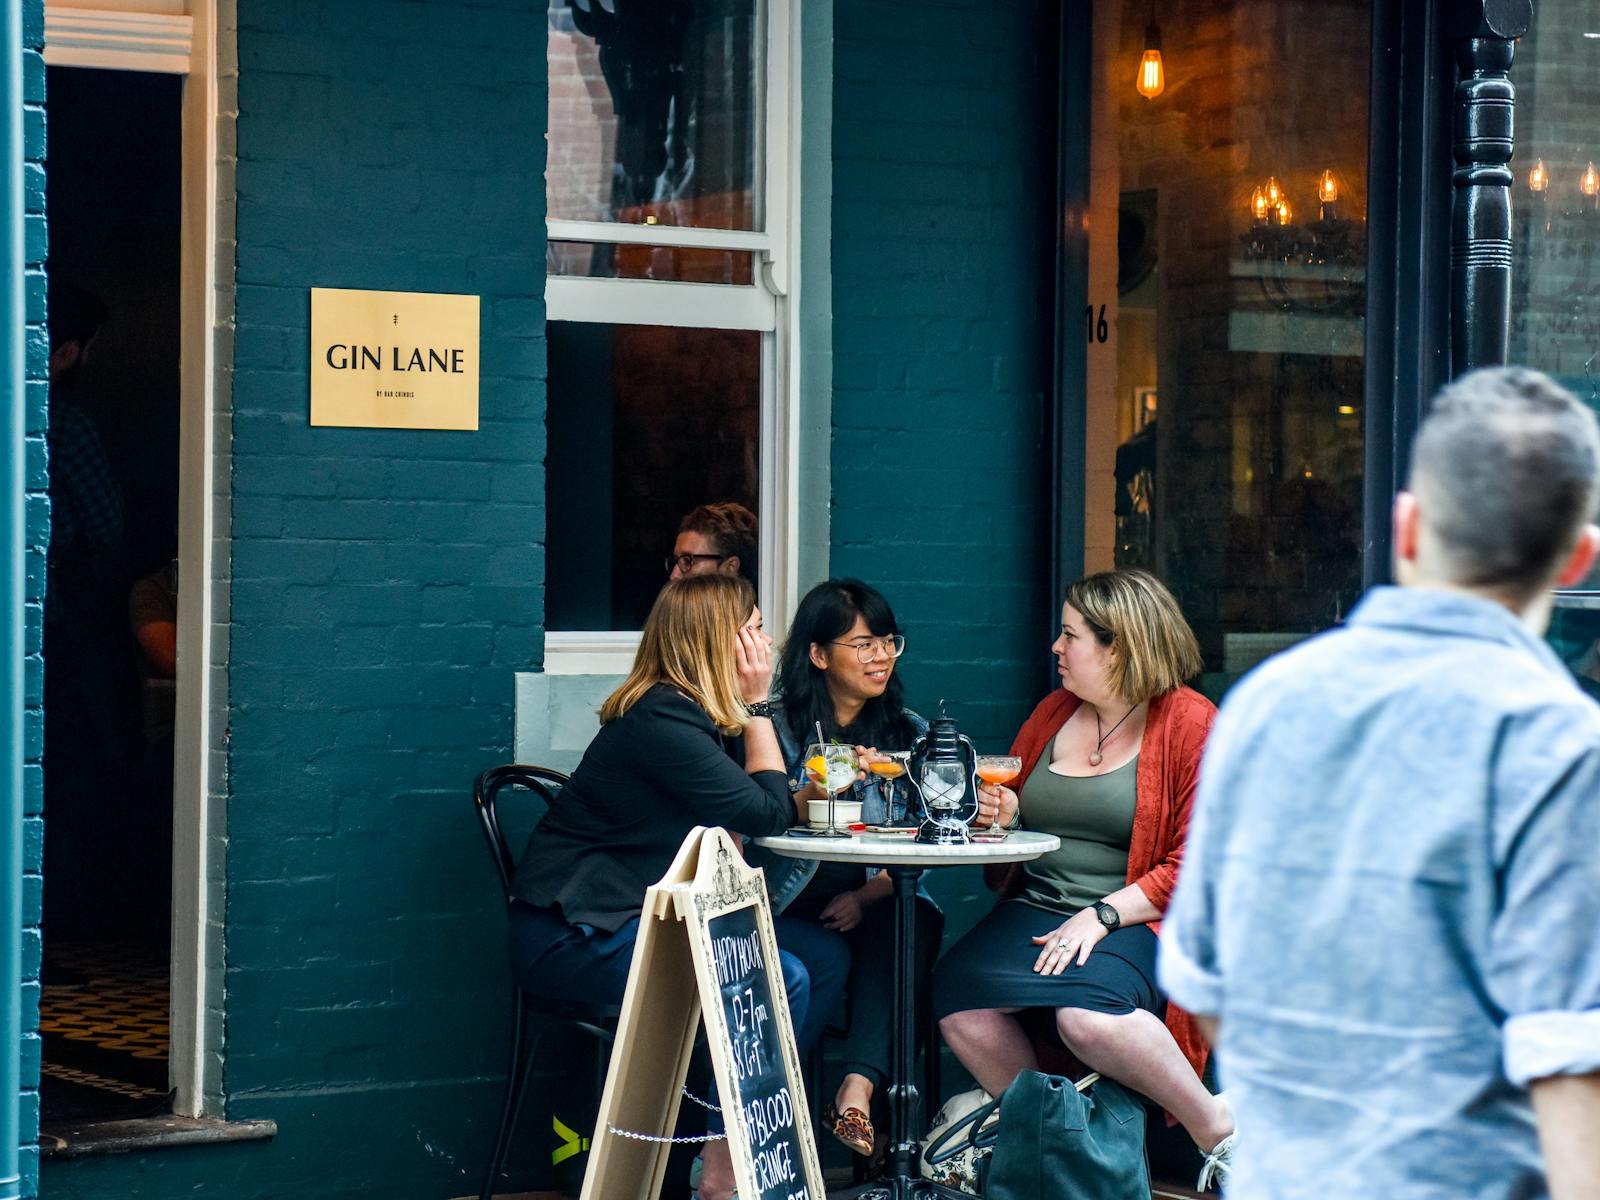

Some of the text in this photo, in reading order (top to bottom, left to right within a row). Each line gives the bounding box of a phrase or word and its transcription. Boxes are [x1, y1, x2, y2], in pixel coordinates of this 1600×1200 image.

[1085, 303, 1108, 344] 16
[326, 344, 464, 374] GIN LANE
[376, 390, 383, 398] BY
[713, 930, 764, 986] HAPPY HOUR
[752, 1087, 793, 1147] BLOOD
[753, 1141, 796, 1194] ORANGE
